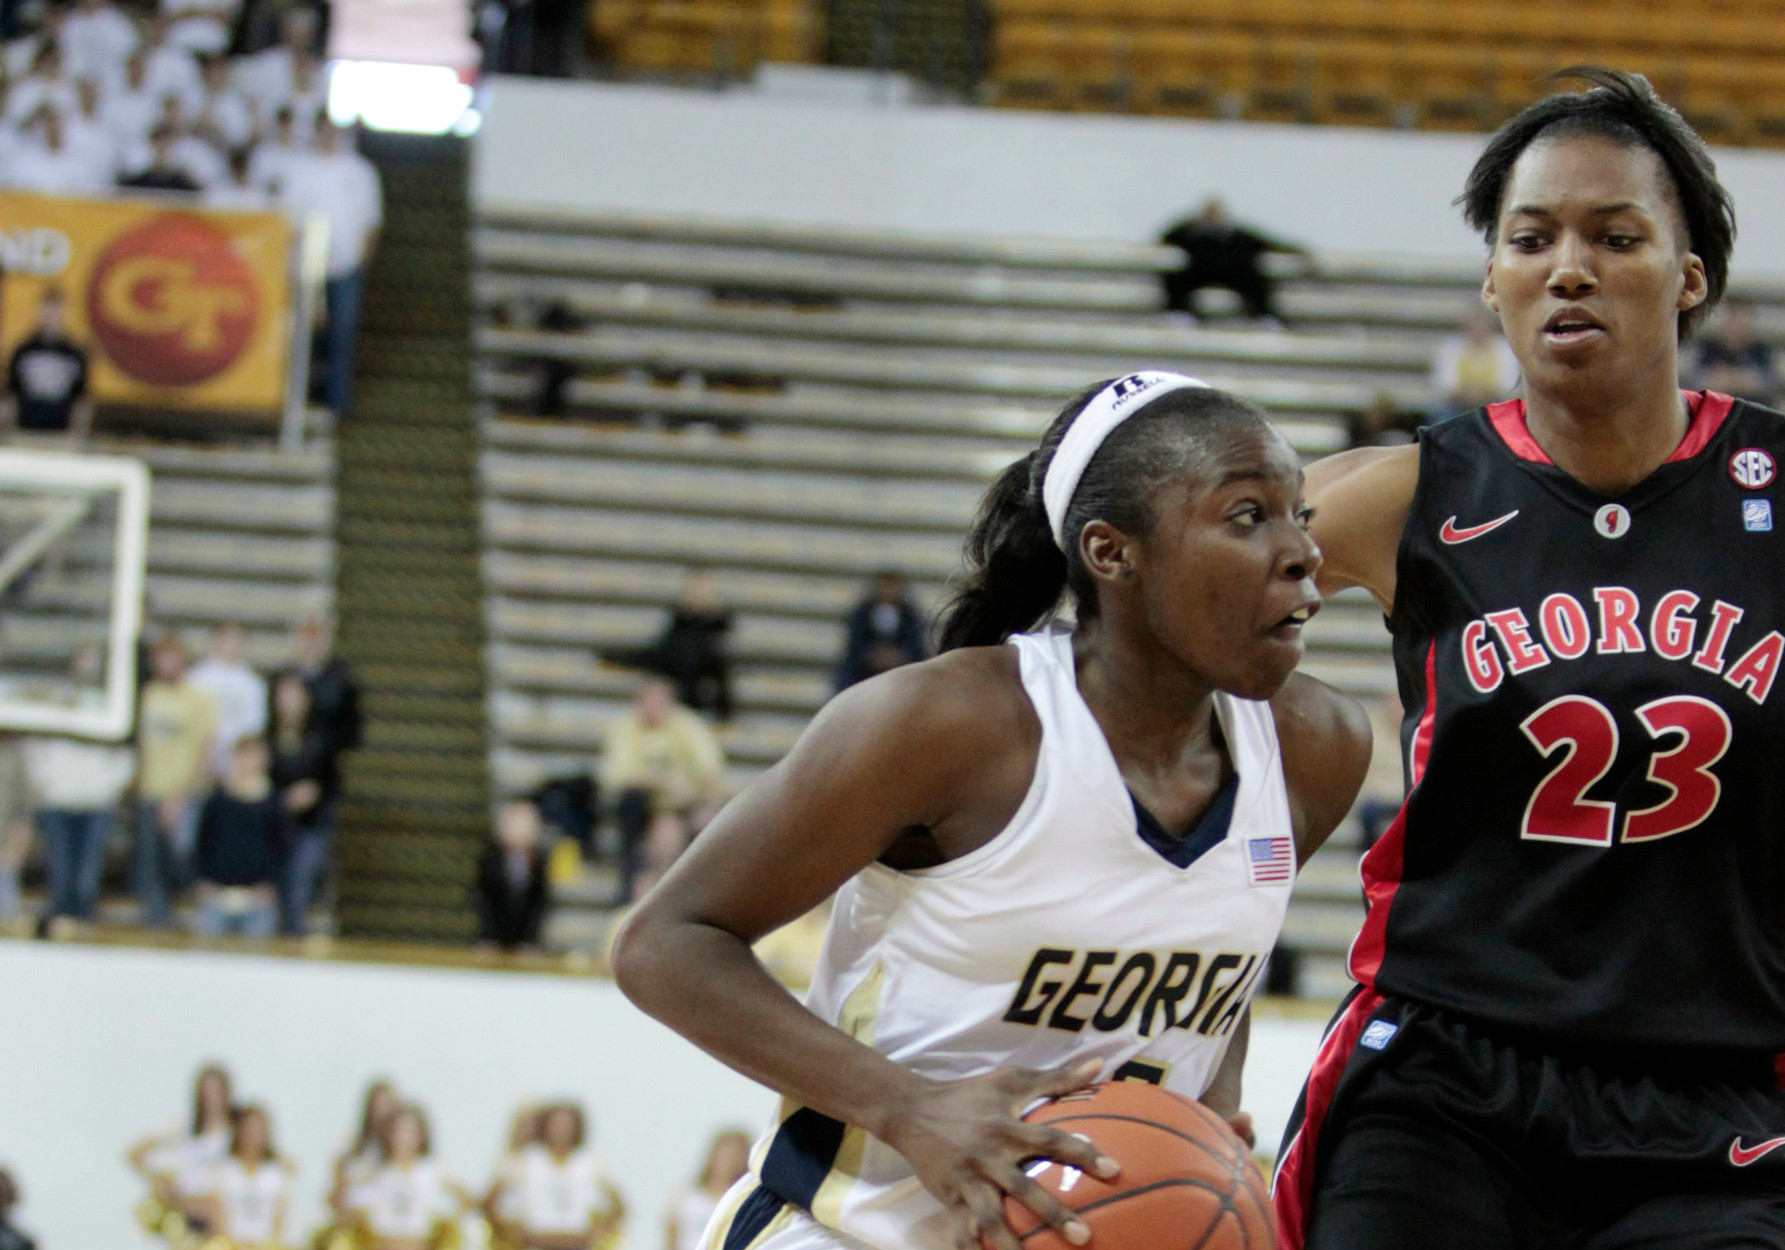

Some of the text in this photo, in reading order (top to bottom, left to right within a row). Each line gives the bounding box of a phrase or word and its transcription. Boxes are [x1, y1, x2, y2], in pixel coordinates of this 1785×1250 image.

[1732, 450, 1774, 487] SEC
[1461, 586, 1785, 705] GEORGIA
[1518, 694, 1733, 848] 23
[1002, 946, 1269, 1038] GEORGIA
